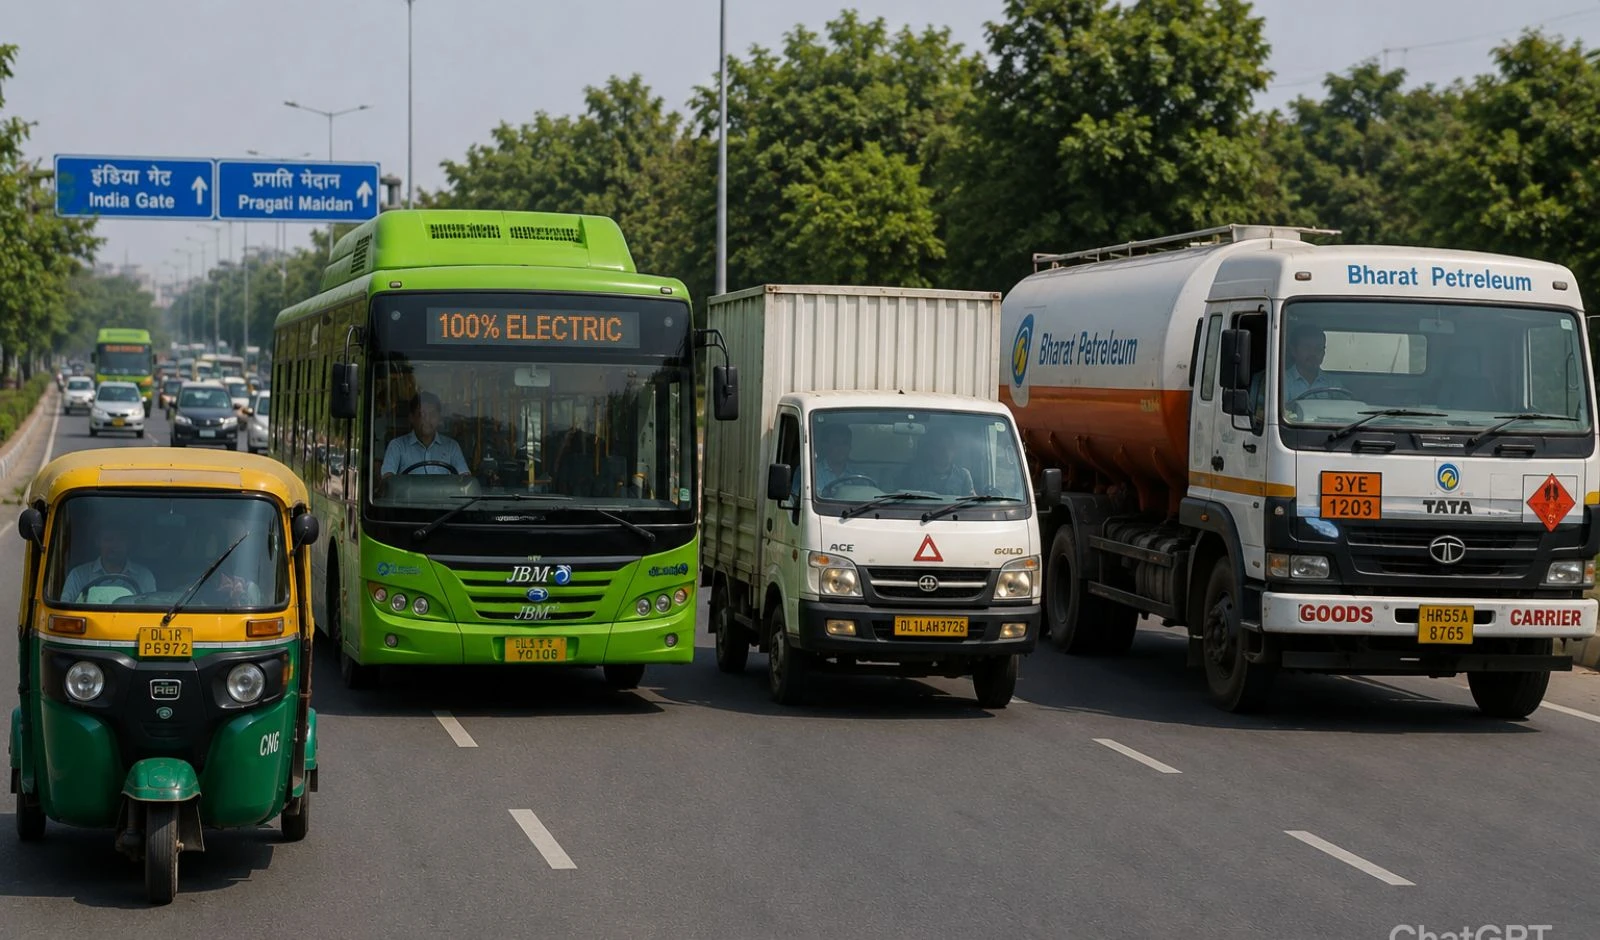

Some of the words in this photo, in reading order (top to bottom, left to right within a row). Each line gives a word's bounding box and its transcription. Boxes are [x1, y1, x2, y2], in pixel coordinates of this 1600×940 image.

[90, 163, 140, 187] इंडिया
[252, 167, 294, 189] प्रगति
[89, 191, 130, 208] India
[135, 191, 175, 209] Gate
[238, 194, 293, 214] Pragati
[298, 195, 354, 212] Maidan
[1347, 264, 1418, 286] Bharat
[1431, 266, 1532, 292] Petreleum
[439, 313, 500, 340] 100%
[506, 313, 623, 342] ELECTRIC
[1039, 332, 1076, 366] Bharat
[1334, 475, 1368, 493] 3YE
[1330, 498, 1372, 517] 1203
[1422, 500, 1472, 515] TATA
[829, 543, 855, 552] ACE
[506, 566, 551, 583] JBM
[1300, 603, 1374, 623] GOODS
[1426, 608, 1468, 623] HR55A
[1510, 608, 1581, 626] CARRIER
[900, 619, 965, 633] DL1LAH3726
[1430, 625, 1465, 641] 8765
[143, 642, 189, 655] P6972
[259, 730, 280, 757] CNG
